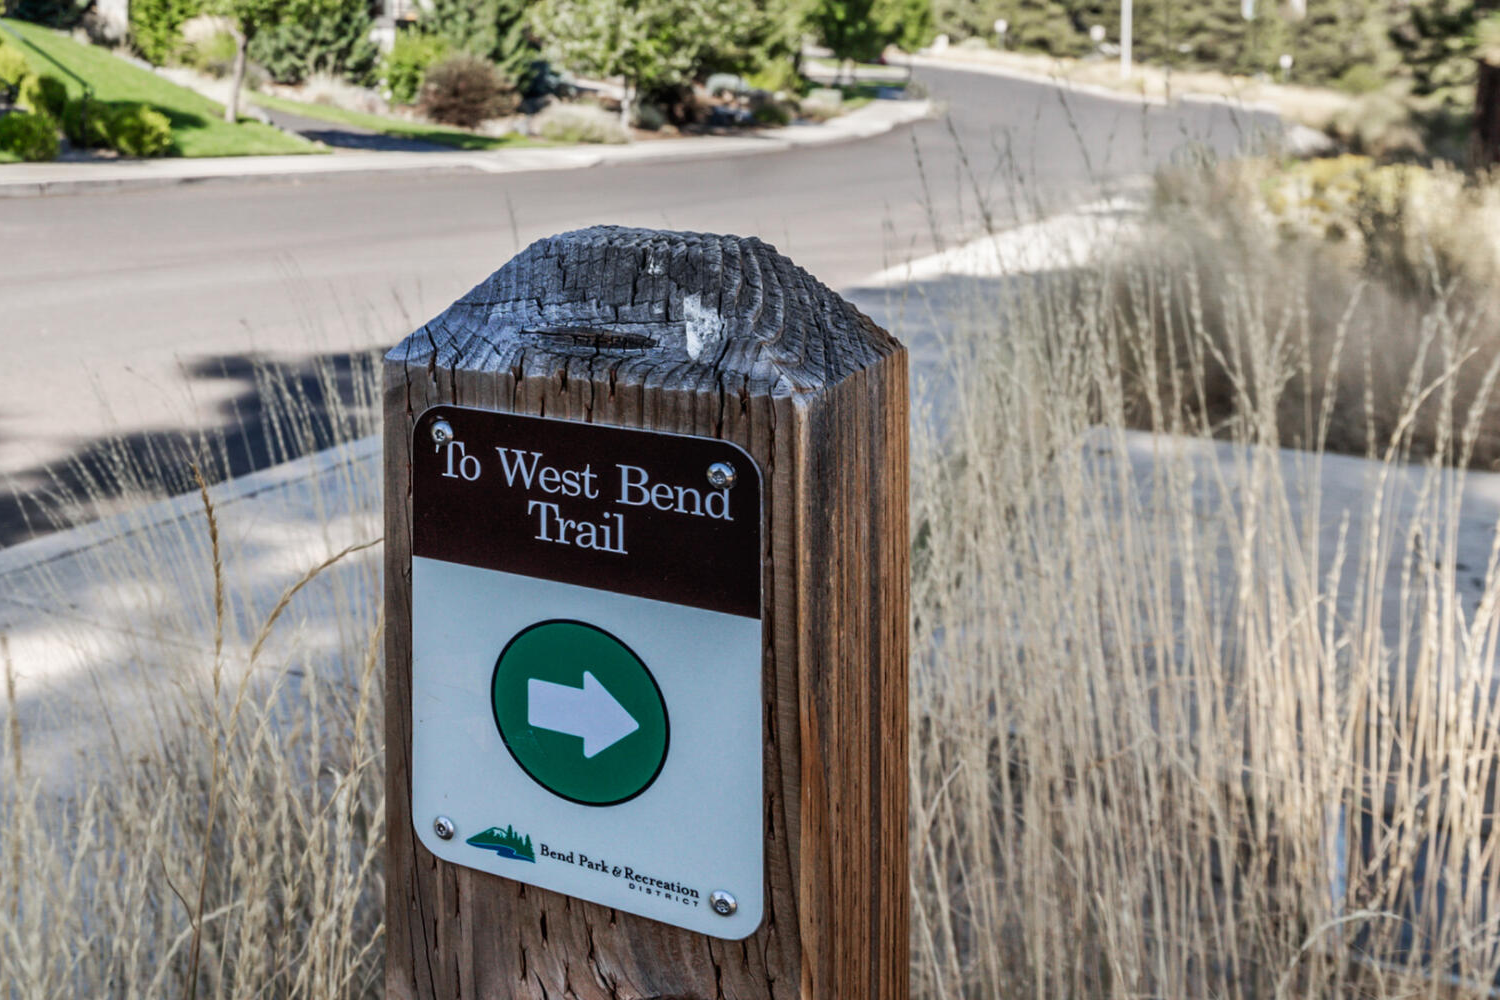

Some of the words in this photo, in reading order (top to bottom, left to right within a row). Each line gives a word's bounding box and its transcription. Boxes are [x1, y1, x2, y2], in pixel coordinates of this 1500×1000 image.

[435, 441, 481, 481] To
[495, 446, 599, 499] West
[615, 464, 734, 521] Bend
[528, 500, 628, 555] Trail
[540, 843, 575, 865] Bend
[578, 855, 610, 875] Park
[611, 865, 622, 878] &
[624, 866, 700, 899] Recreation
[628, 883, 699, 908] DISTRICT
